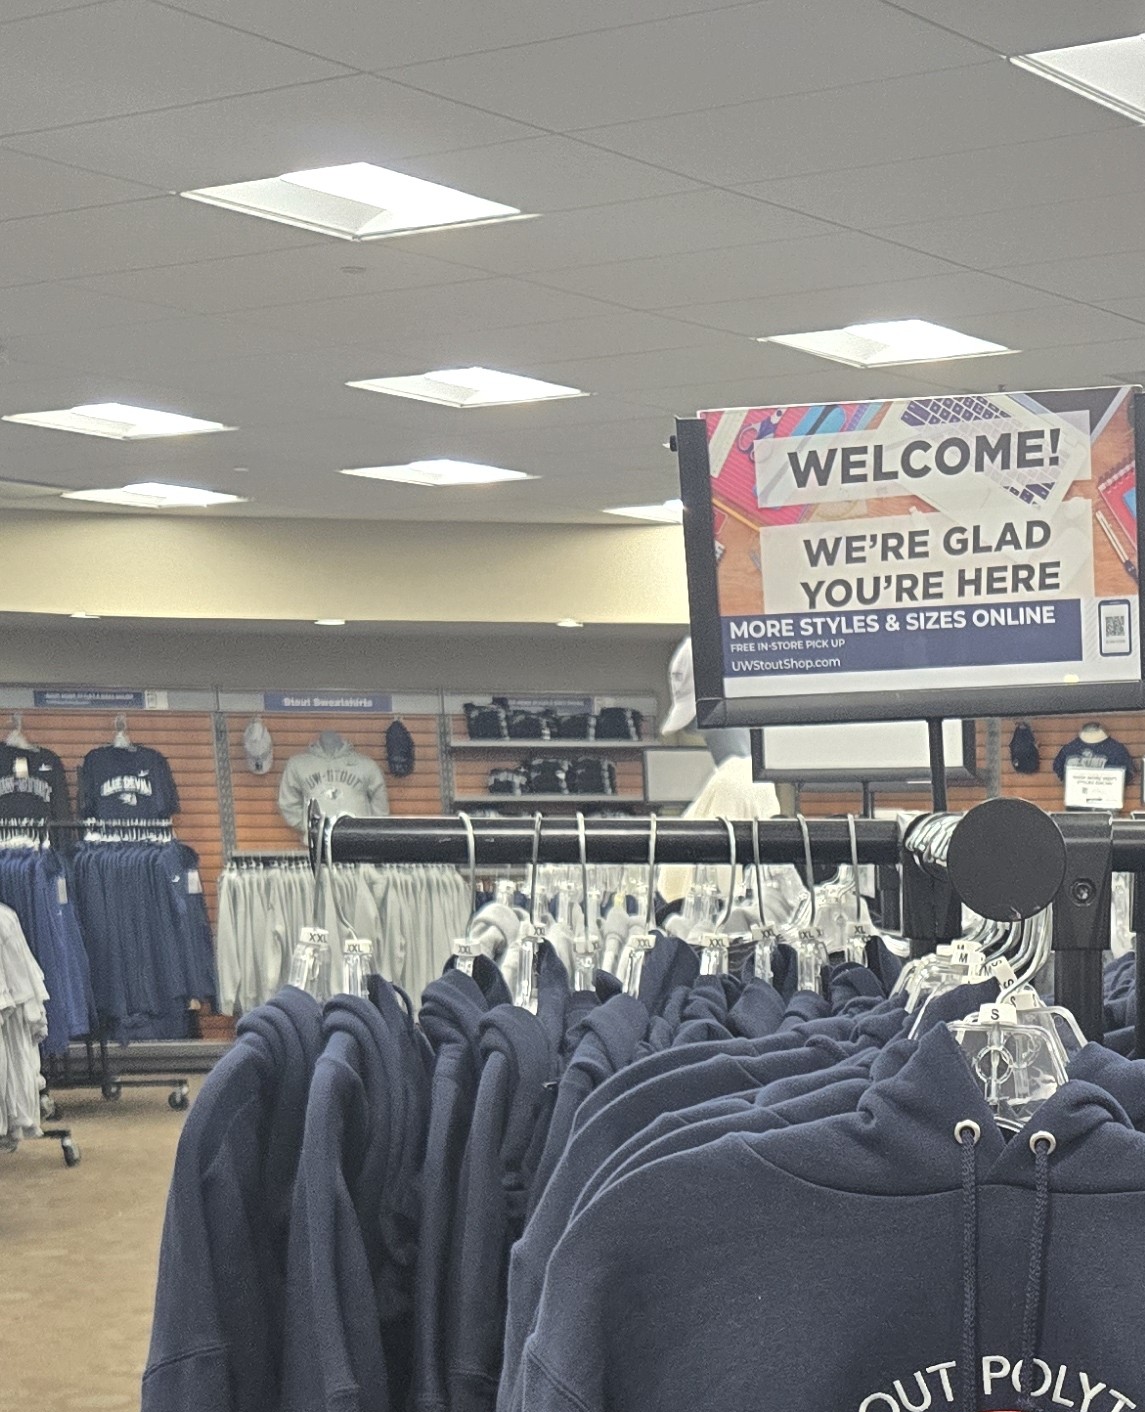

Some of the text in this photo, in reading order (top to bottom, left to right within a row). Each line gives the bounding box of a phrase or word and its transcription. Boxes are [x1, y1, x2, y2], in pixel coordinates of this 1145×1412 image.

[787, 428, 1061, 488] WELCOME!
[803, 520, 1051, 567] WE'RE GLAD
[800, 561, 1061, 609] YOU'RE HERE
[730, 605, 1056, 640] MORE STYLES & SIZES ONLINE
[730, 638, 846, 653] FREE IN-STORE PICK UP
[731, 656, 841, 672] UWStoutShop.com
[959, 952, 968, 963] M
[991, 1008, 1000, 1020] S
